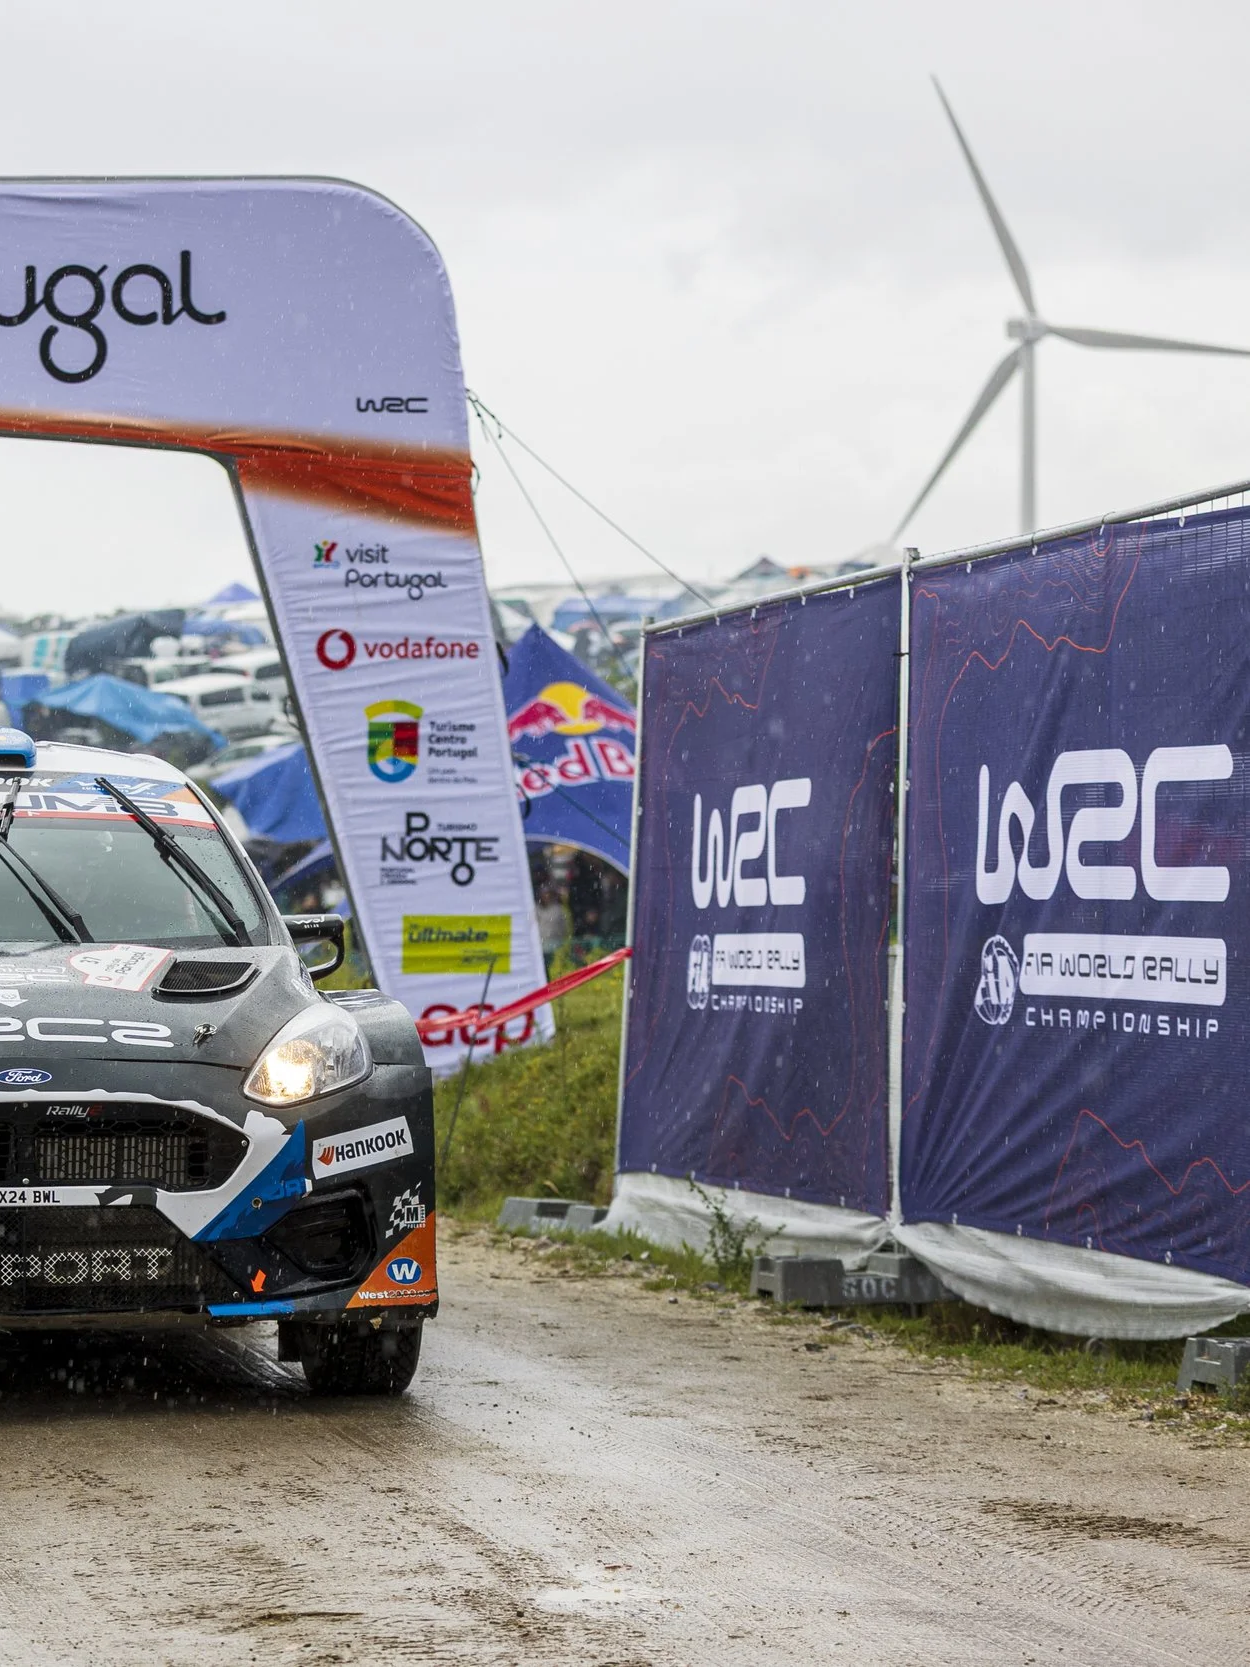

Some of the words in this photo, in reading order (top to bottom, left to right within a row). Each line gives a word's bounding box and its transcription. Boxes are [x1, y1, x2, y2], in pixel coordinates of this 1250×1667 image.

[356, 397, 428, 413] WRC
[345, 543, 390, 564] visit
[345, 569, 447, 600] Portugal
[364, 637, 479, 659] vodafone
[430, 721, 476, 732] Turismo
[428, 746, 478, 760] Portugal
[516, 740, 596, 800] ed
[976, 744, 1234, 905] WRC
[691, 777, 812, 909] WRC
[1025, 953, 1053, 976] FIA
[1142, 956, 1220, 985] RALLY
[1025, 1006, 1219, 1040] CHAMPIONSHIP
[5, 1070, 43, 1083] Ford
[33, 1191, 61, 1203] BWL
[392, 1261, 418, 1280] W
